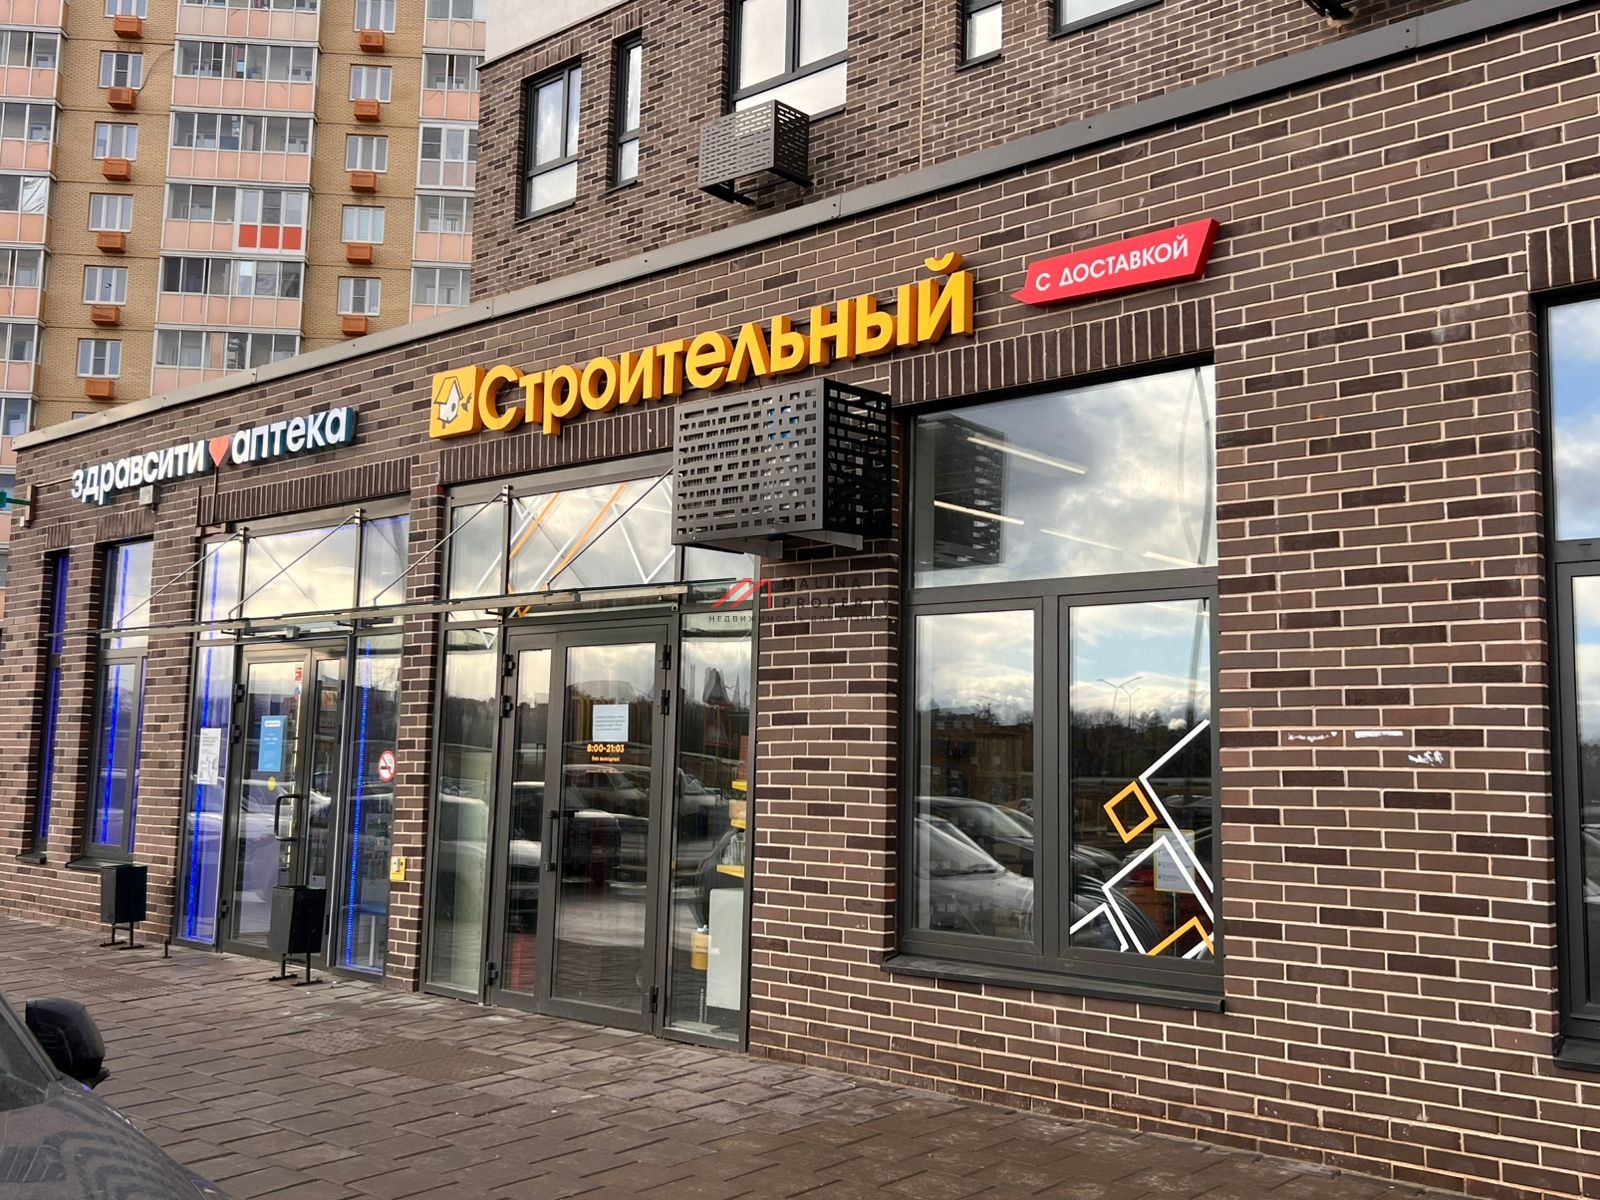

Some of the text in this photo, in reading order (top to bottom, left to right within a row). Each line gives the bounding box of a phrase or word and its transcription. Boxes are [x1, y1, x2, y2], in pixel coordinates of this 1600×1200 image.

[1035, 234, 1189, 291] С ДОСТАВКОЙ
[478, 251, 973, 436] Строительный
[71, 407, 349, 505] здравсити аптека
